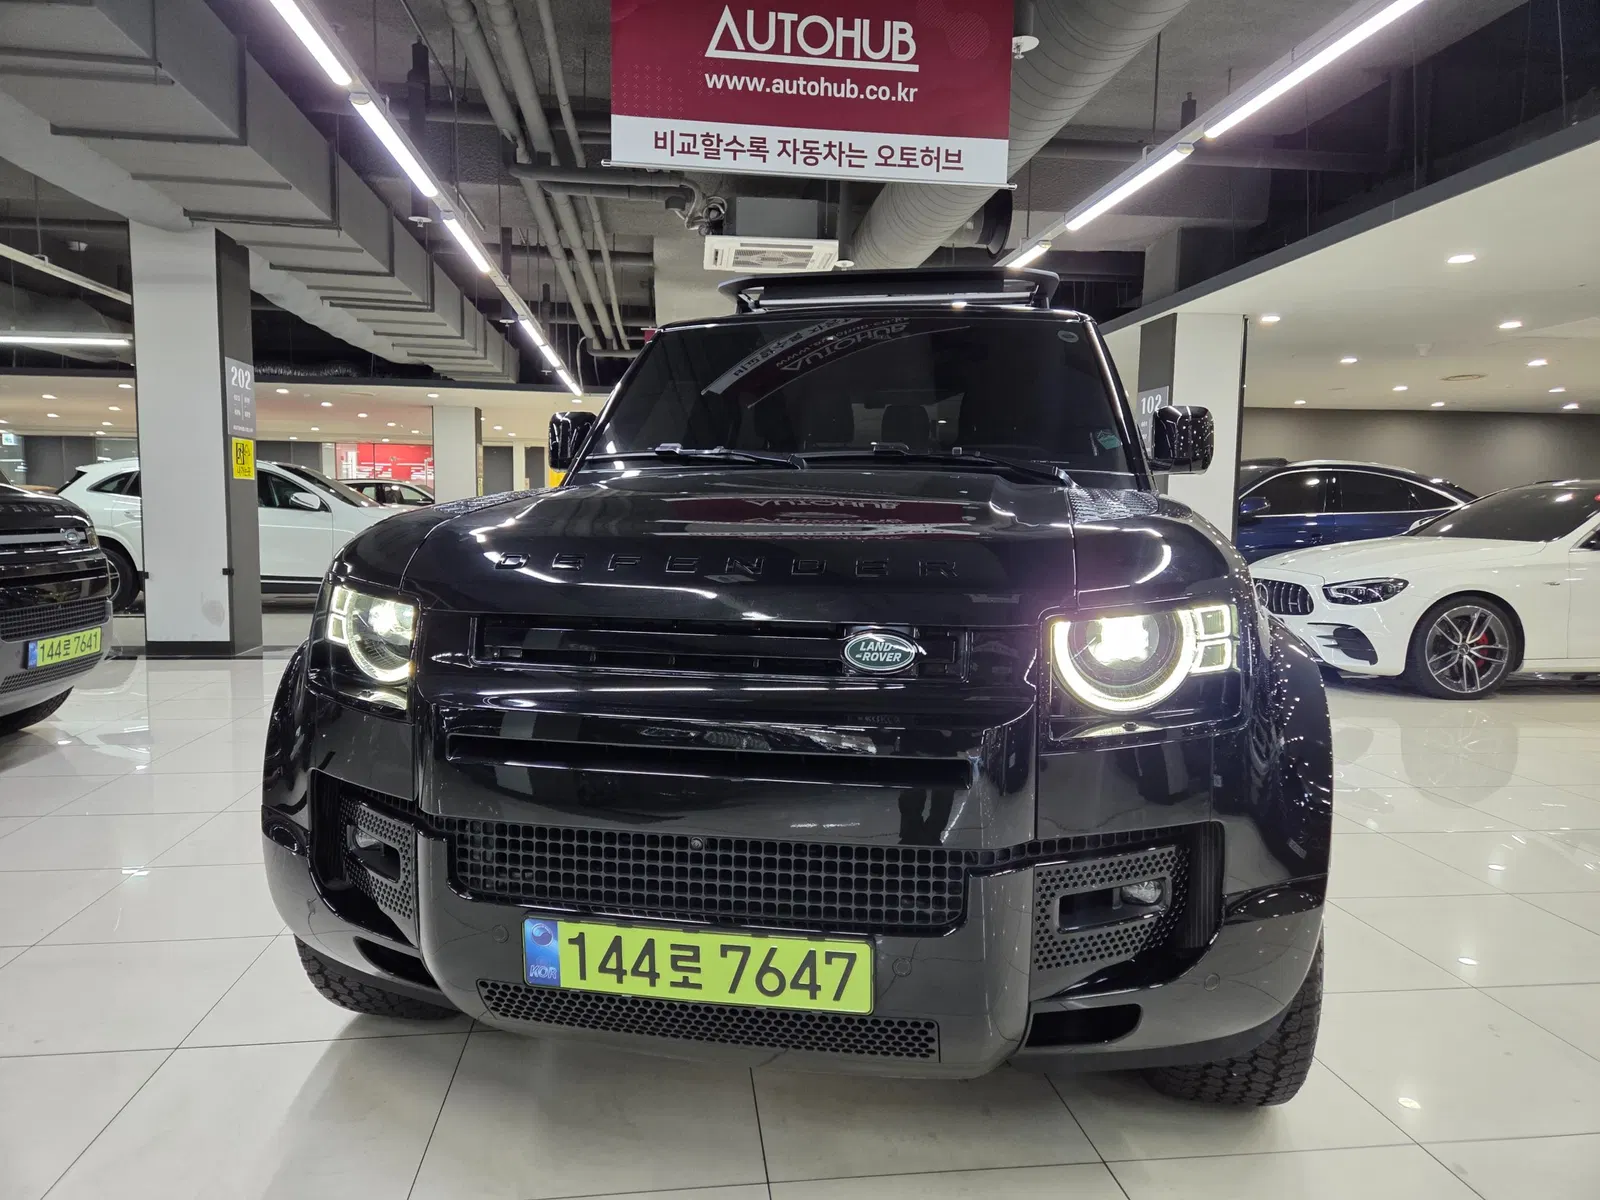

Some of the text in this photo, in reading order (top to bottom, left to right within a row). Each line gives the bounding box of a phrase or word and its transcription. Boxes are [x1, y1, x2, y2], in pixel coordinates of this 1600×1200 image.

[704, 4, 918, 72] AUTOHUB
[704, 73, 918, 103] www.autohub.co.kr
[654, 129, 964, 172] 비교할수록 자동차는 오토허브
[231, 366, 251, 390] 202
[1141, 394, 1162, 415] 102
[495, 552, 958, 576] DEFENDER
[40, 639, 70, 662] 144로
[74, 631, 97, 654] 7641
[860, 641, 892, 652] LAND
[862, 652, 902, 662] ROVER
[529, 931, 857, 1001] KOR 144로 7647
